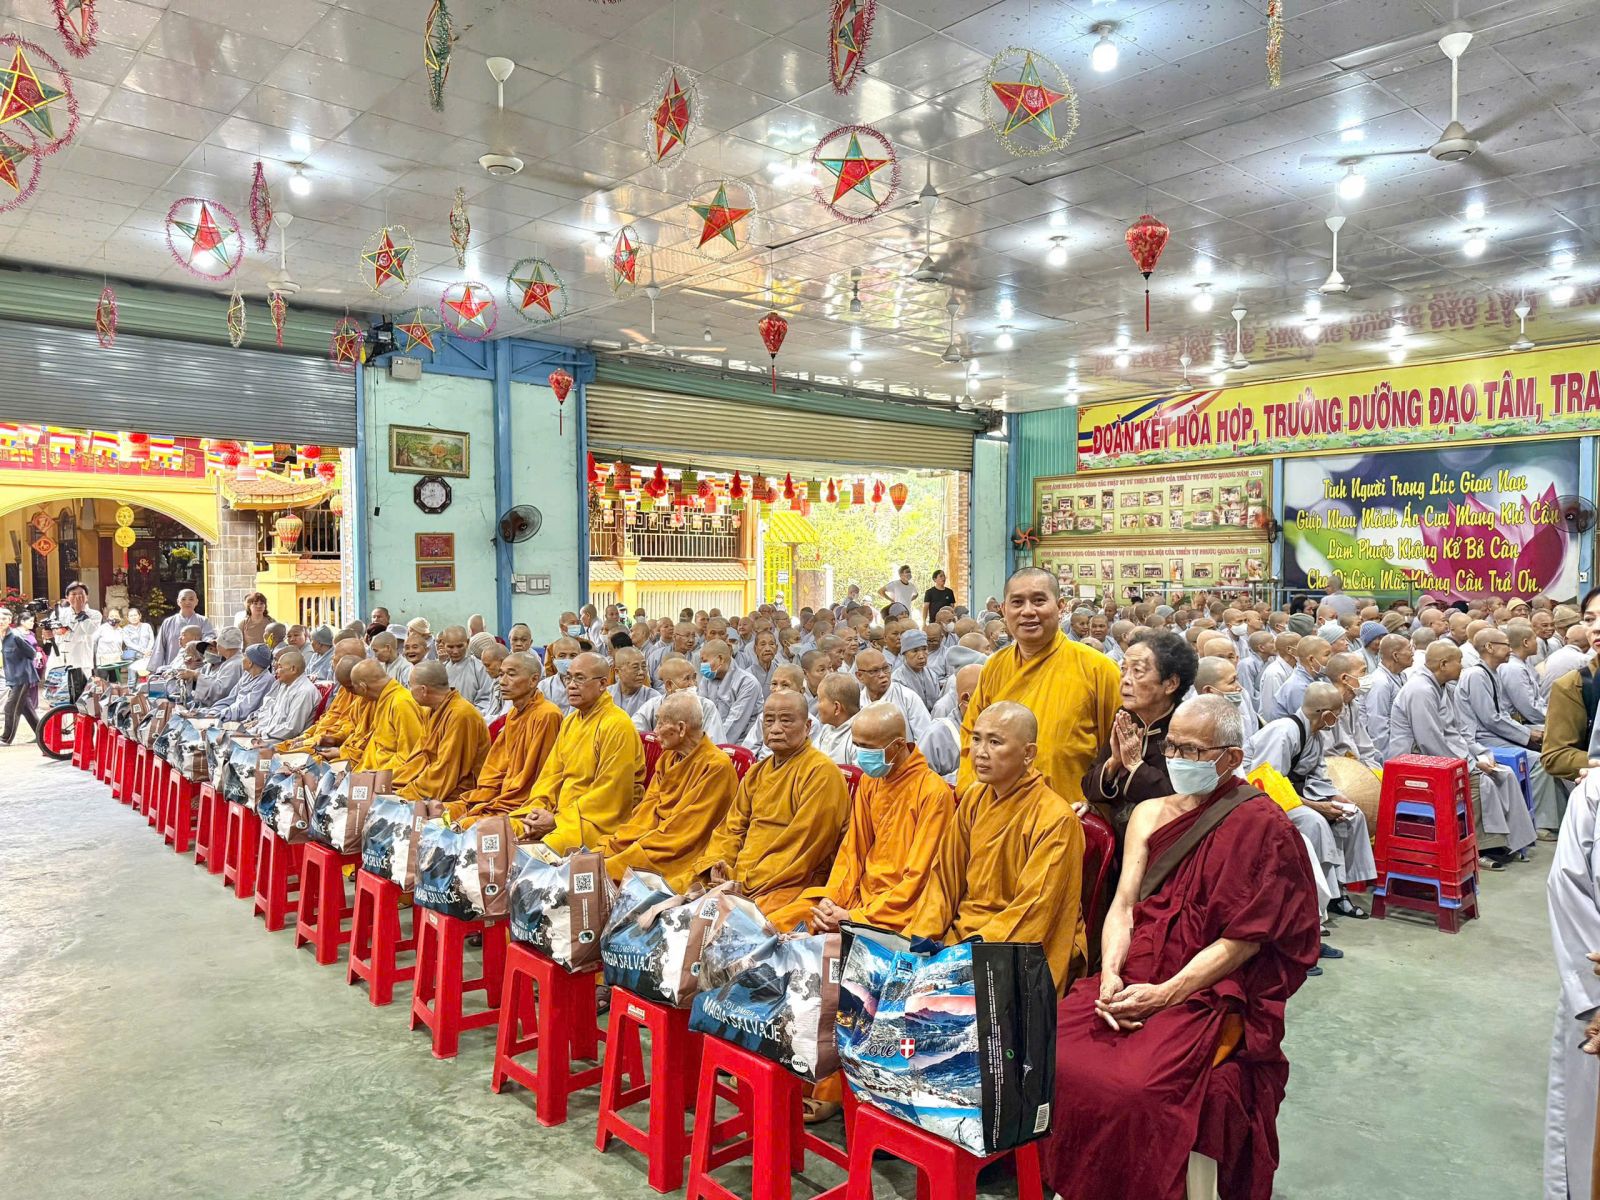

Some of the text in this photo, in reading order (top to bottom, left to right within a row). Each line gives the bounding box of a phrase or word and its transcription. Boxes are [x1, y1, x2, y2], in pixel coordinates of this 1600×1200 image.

[1093, 414, 1136, 455] ĐOÀN
[1139, 404, 1172, 450] KẾT
[1176, 405, 1211, 447] HÒA
[1216, 402, 1258, 452] HỢP,
[1263, 386, 1343, 438] TRƯỞNG
[1348, 381, 1423, 431] DƯỠNG
[1429, 383, 1477, 436] ĐẠO
[1483, 369, 1543, 425] TÂM,
[1323, 469, 1528, 502] Tình Người Trong Lúc Gian Nan
[1296, 510, 1323, 534] Giúp
[1327, 509, 1357, 529] Nhau
[1402, 501, 1420, 529] Áo
[1455, 505, 1496, 531] Mang
[1500, 502, 1526, 525] Khi
[1327, 539, 1354, 560] Làm
[1398, 538, 1438, 564] Không
[1351, 569, 1376, 590] Còn
[1455, 569, 1484, 592] Cần
[1488, 569, 1513, 593] Trả
[703, 995, 781, 1042] MAGIA SALVAJE
